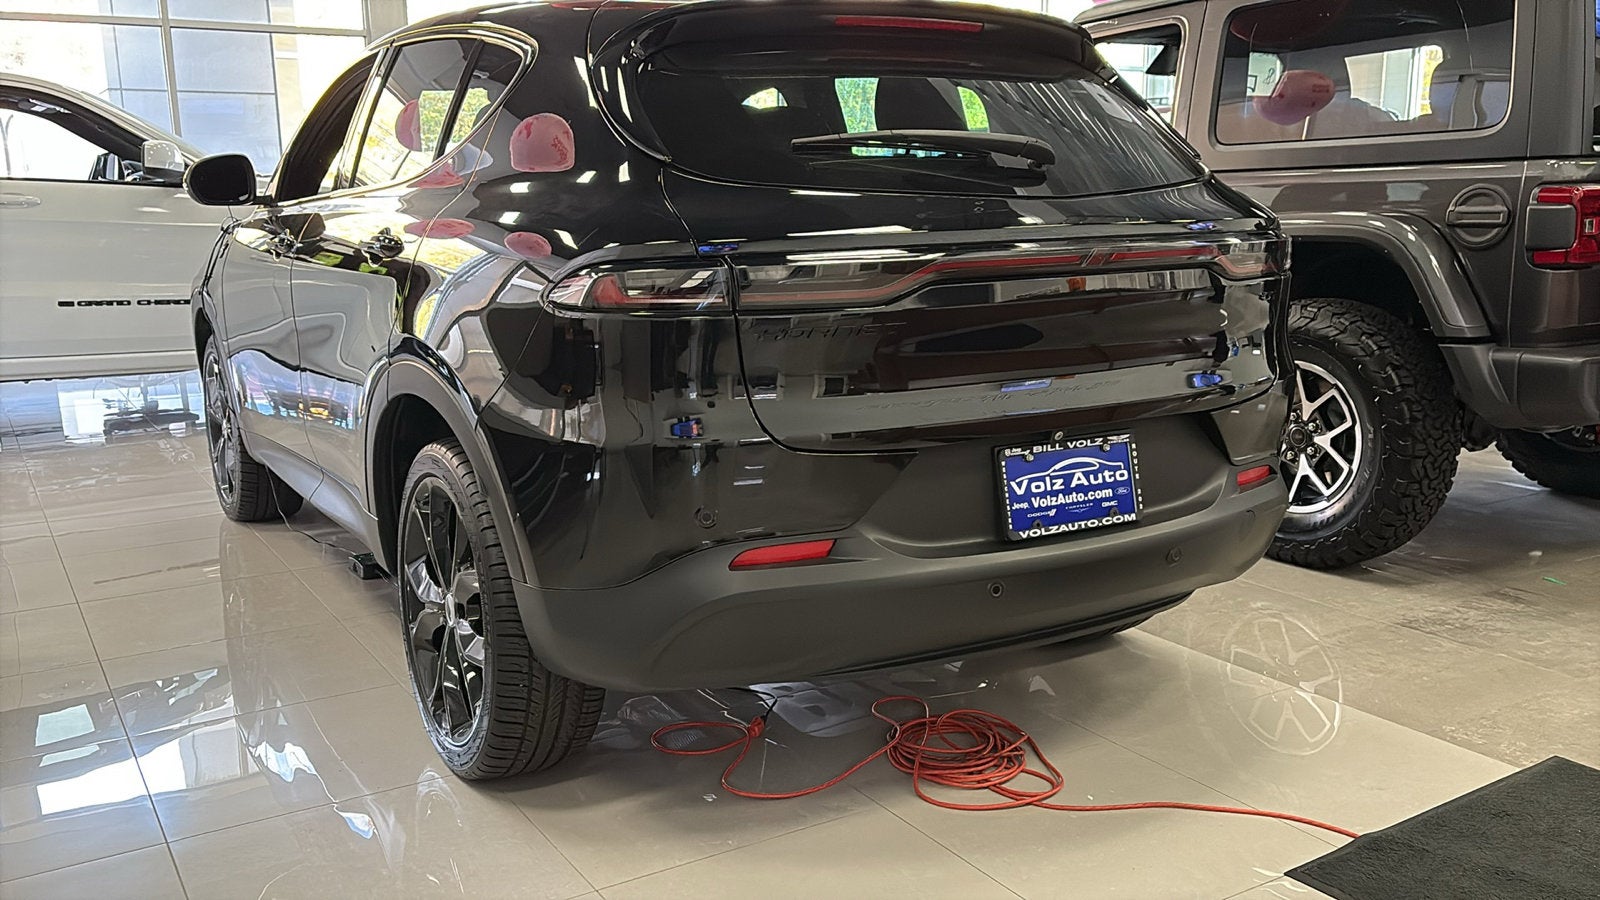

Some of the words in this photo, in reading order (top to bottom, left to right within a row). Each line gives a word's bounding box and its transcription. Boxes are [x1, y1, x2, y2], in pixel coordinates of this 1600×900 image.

[1033, 442, 1064, 454] BILL
[1066, 437, 1104, 449] VOLZ
[1131, 443, 1140, 480] ROUTE
[1010, 476, 1065, 496] Volz
[1070, 469, 1129, 488] Auto
[1012, 502, 1030, 510] Jeep
[1031, 488, 1113, 508] VolzAuto.com
[1101, 500, 1118, 508] GMC
[1018, 513, 1137, 539] VOLZAUTO.COM
